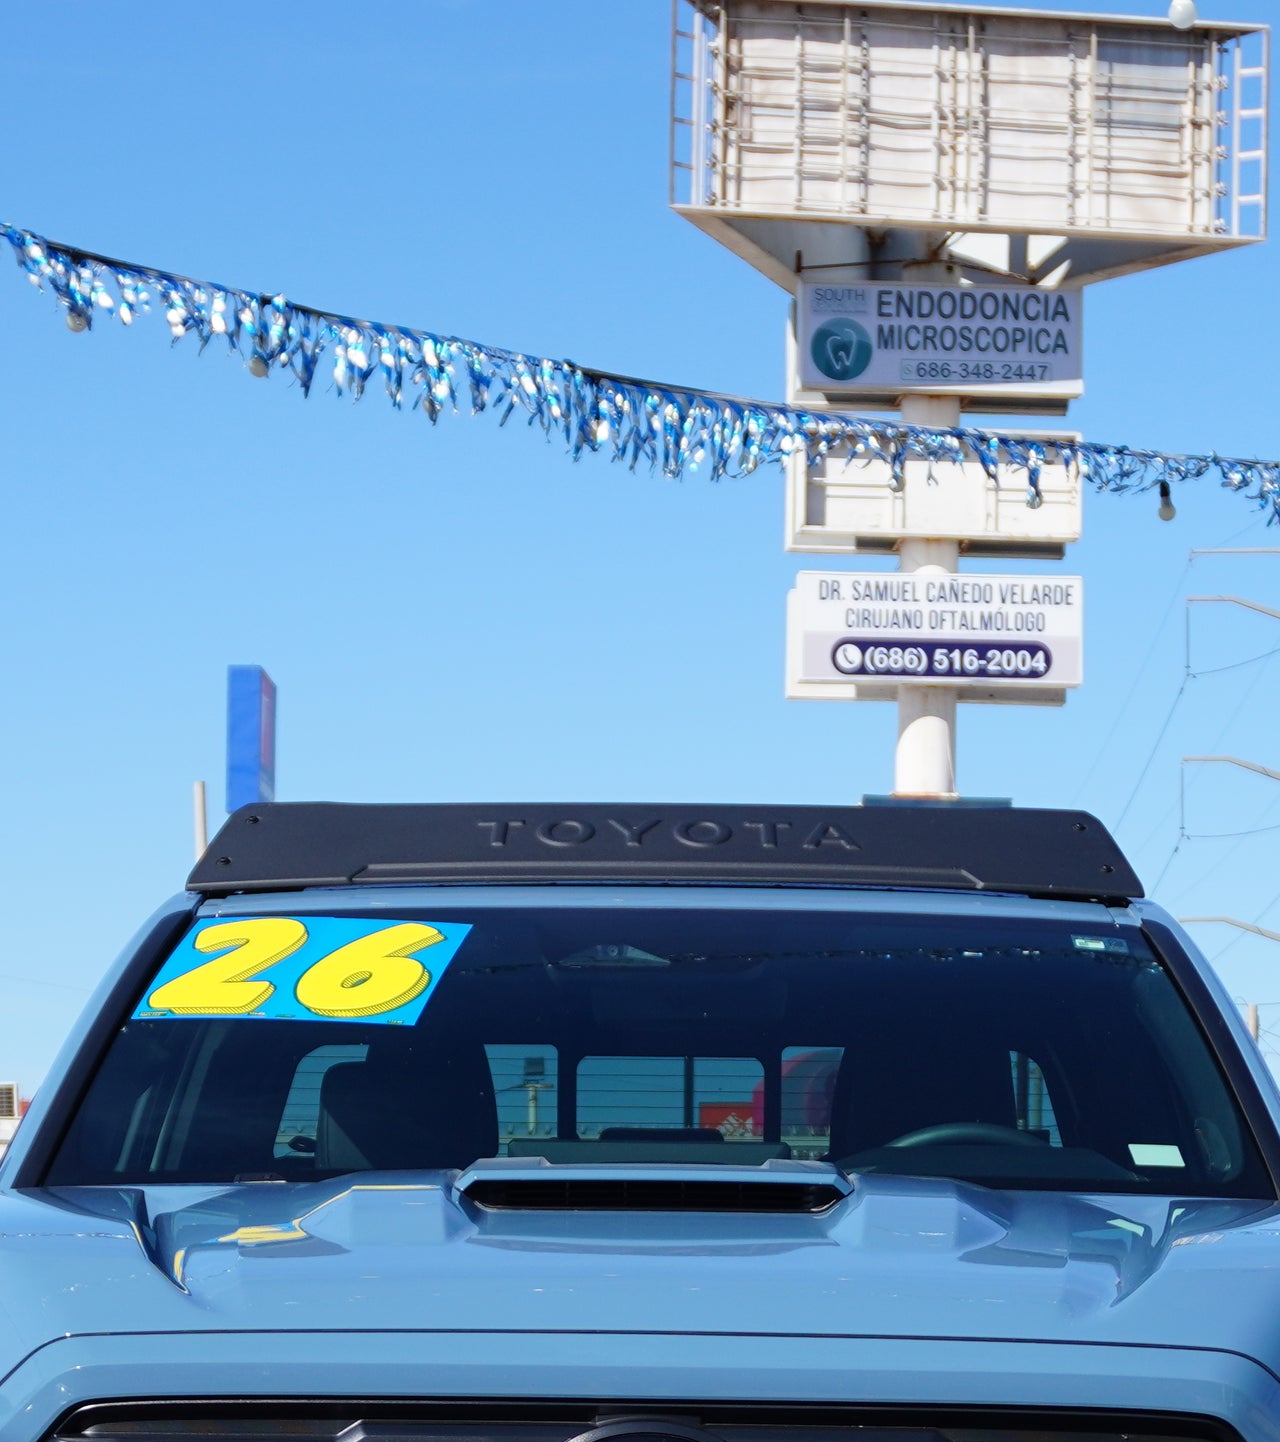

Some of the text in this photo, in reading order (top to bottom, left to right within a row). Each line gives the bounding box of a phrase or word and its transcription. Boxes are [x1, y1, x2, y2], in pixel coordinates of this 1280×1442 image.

[814, 287, 865, 301] SOUTH
[877, 289, 1070, 322] ENDODONCIA
[876, 324, 1069, 354] MICROSCOPICA
[916, 361, 1049, 381] 686-348-2447
[819, 577, 1074, 606] DR. SAMUEL CAÑEDO VELARDE
[845, 606, 1046, 632] CIRUJANO OFTALMÓLOGO
[864, 645, 1048, 676] (686) 516-2004
[477, 818, 862, 851] TOYOTA
[148, 917, 447, 1018] 26
